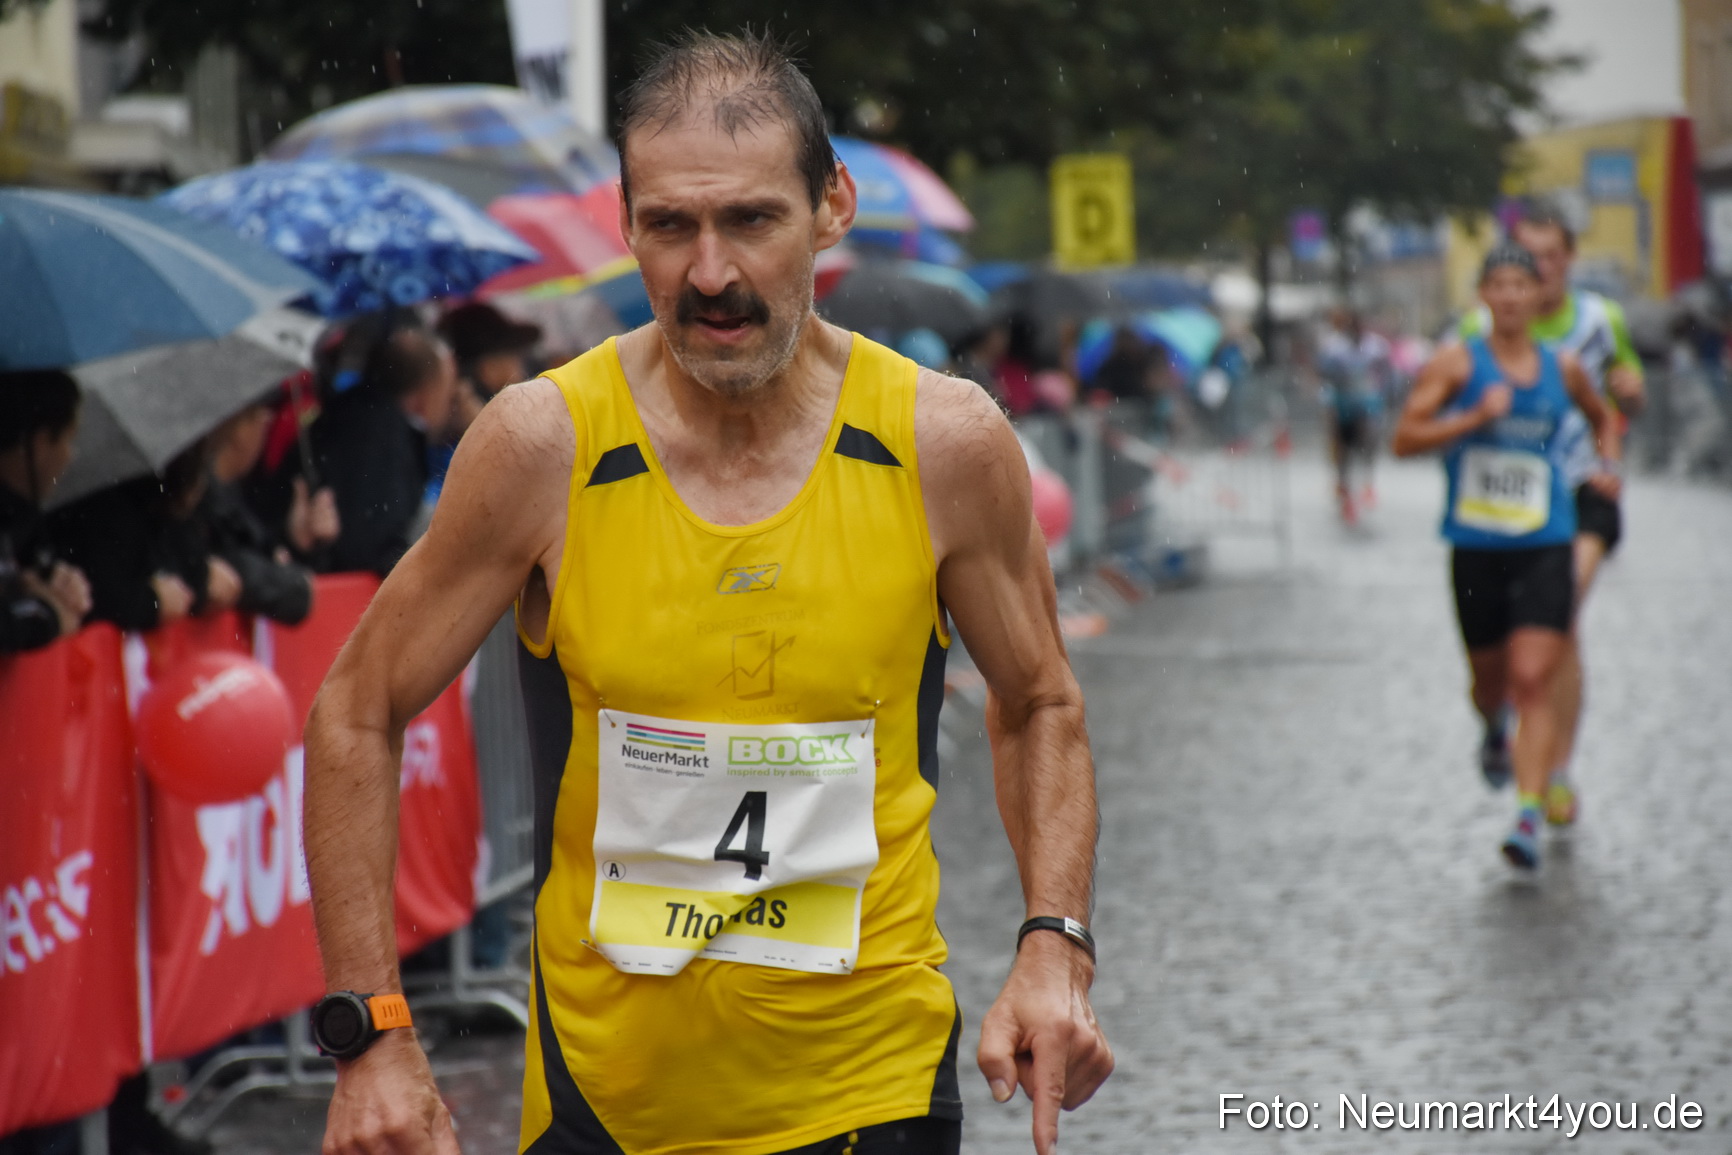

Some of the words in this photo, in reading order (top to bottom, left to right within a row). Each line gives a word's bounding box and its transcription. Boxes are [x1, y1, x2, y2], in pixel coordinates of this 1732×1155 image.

[621, 744, 709, 768] NeuerMarkt
[728, 733, 857, 765] BOCK
[727, 767, 771, 777] inspired
[773, 768, 785, 777] by
[789, 768, 820, 777] smart
[823, 766, 858, 777] concepts
[714, 791, 770, 881] 4
[609, 863, 619, 878] A
[665, 896, 788, 940] Thoas
